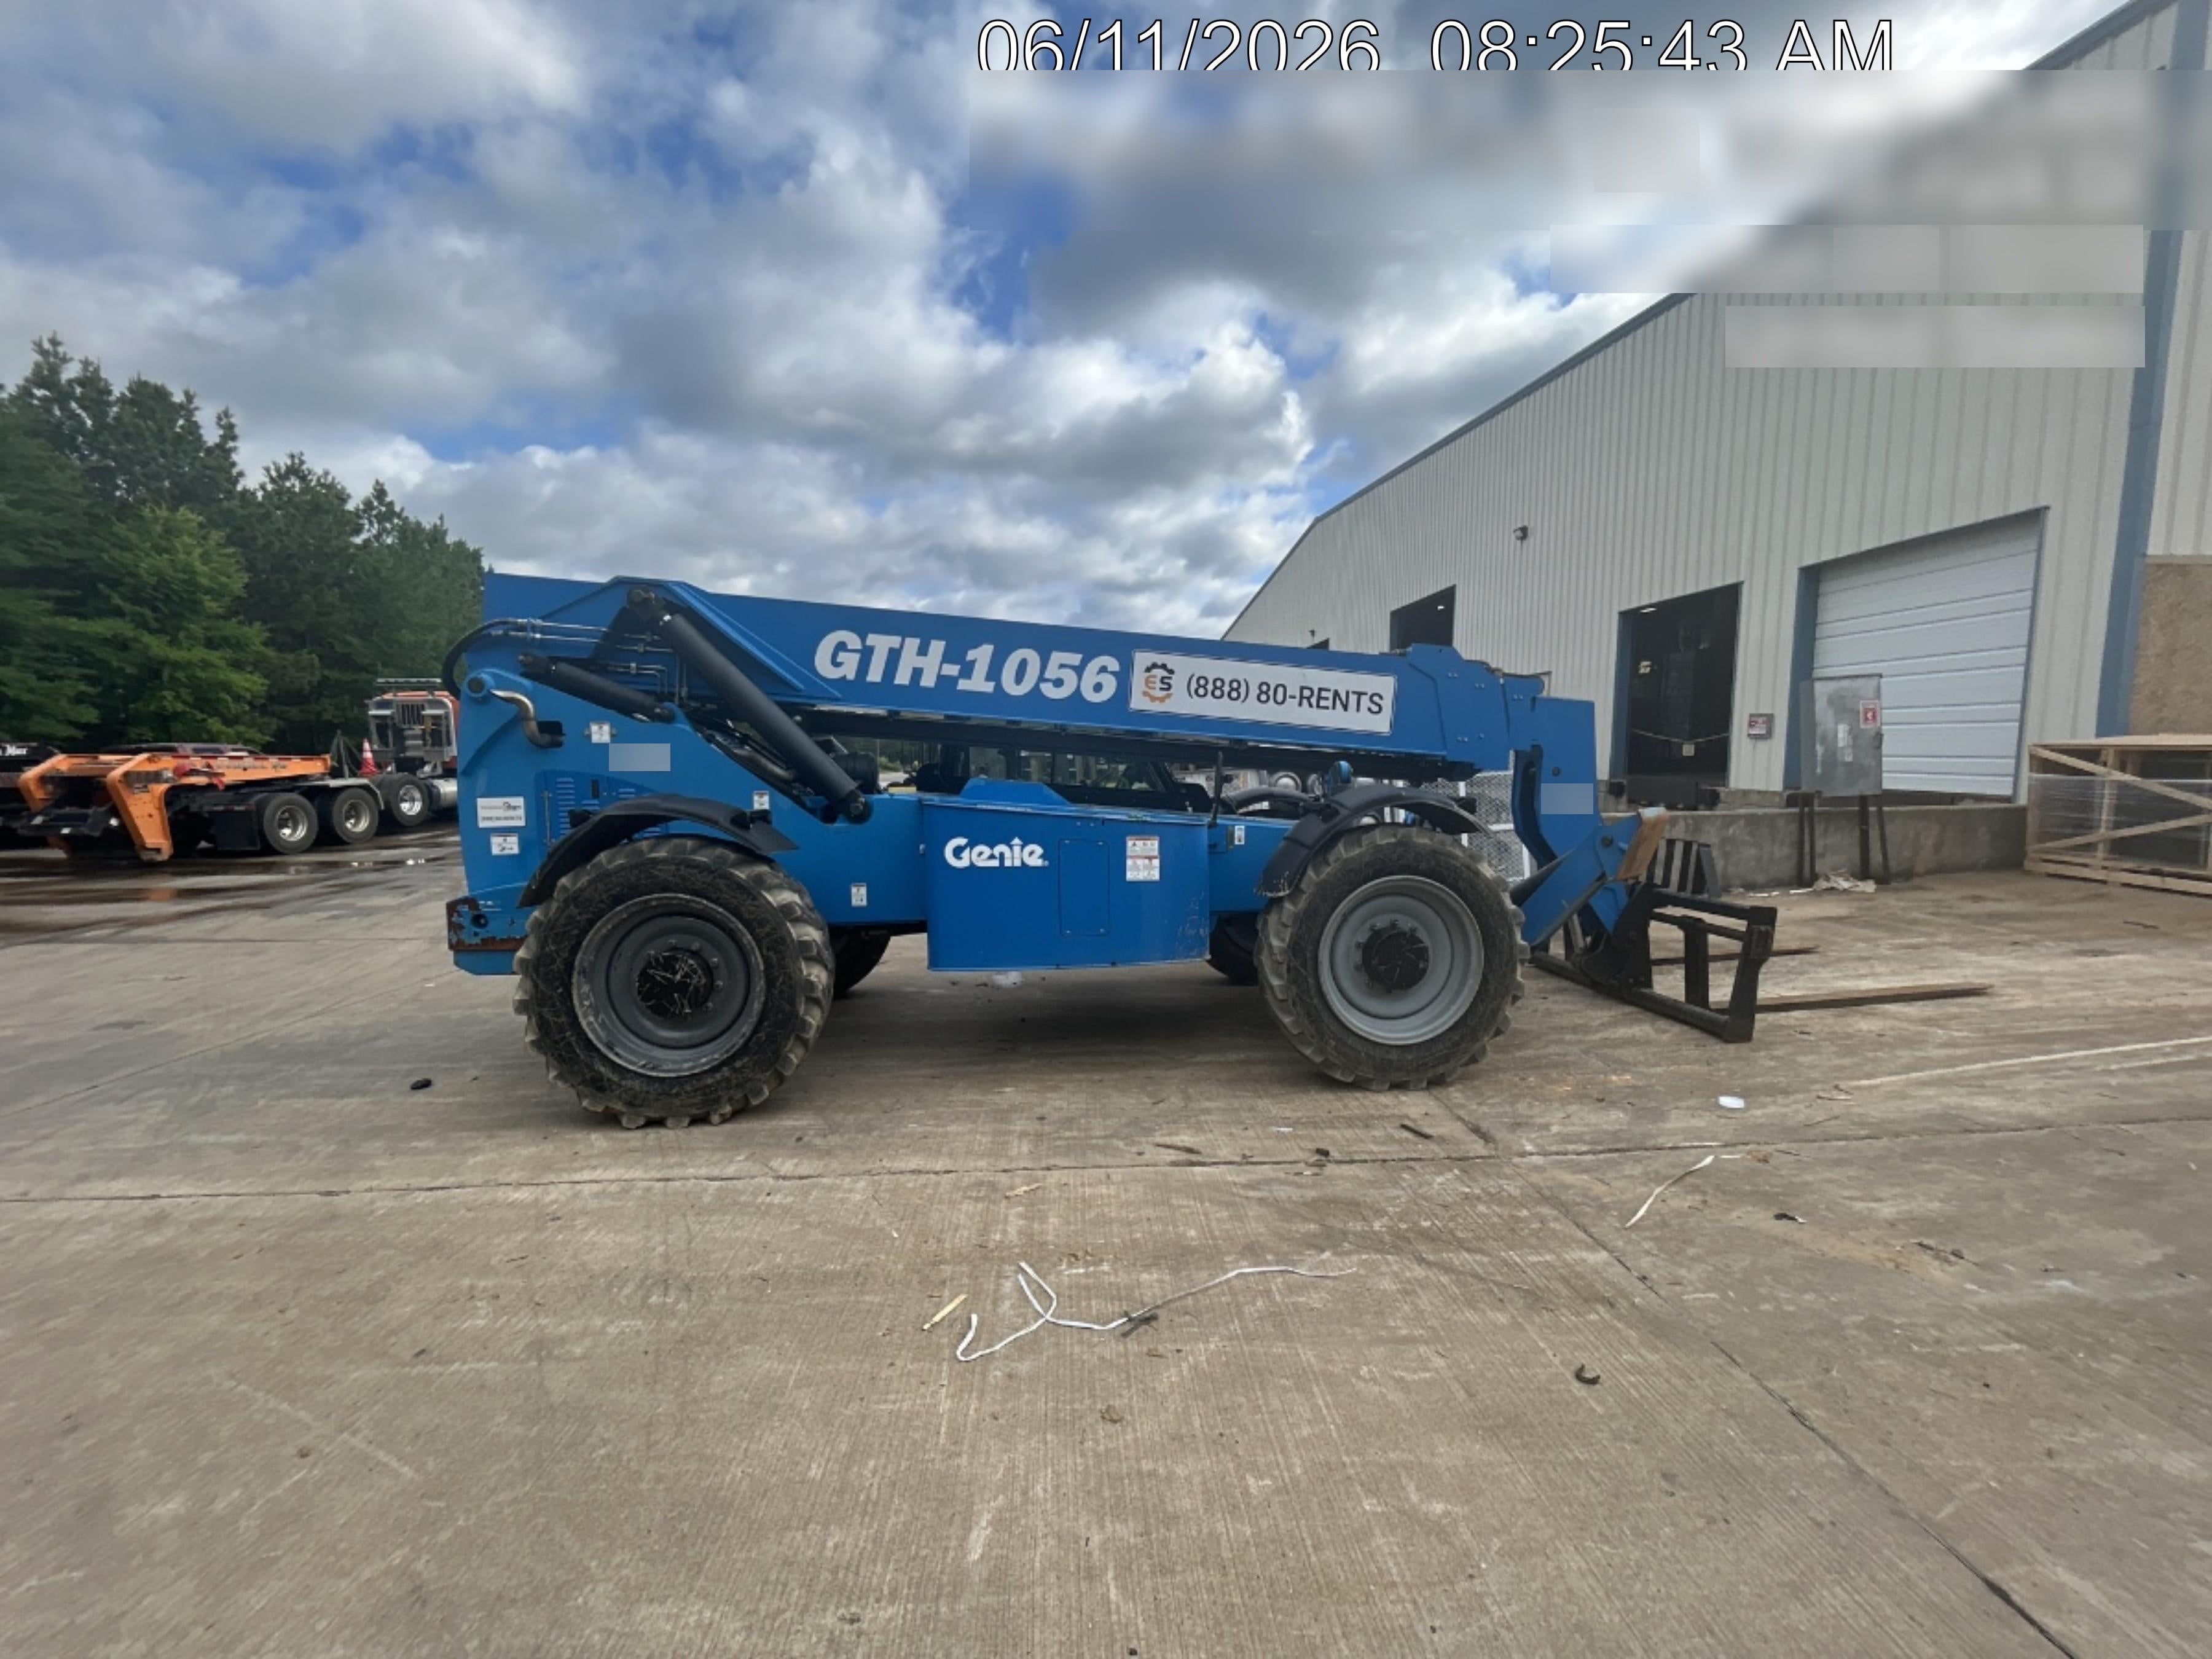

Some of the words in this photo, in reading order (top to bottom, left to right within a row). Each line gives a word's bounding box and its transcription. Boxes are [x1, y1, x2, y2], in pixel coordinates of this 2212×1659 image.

[814, 630, 1120, 702] GTH-1056
[1186, 673, 1250, 704] (888)
[1257, 681, 1384, 715] 80-RENTS
[944, 836, 1045, 869] Genie
